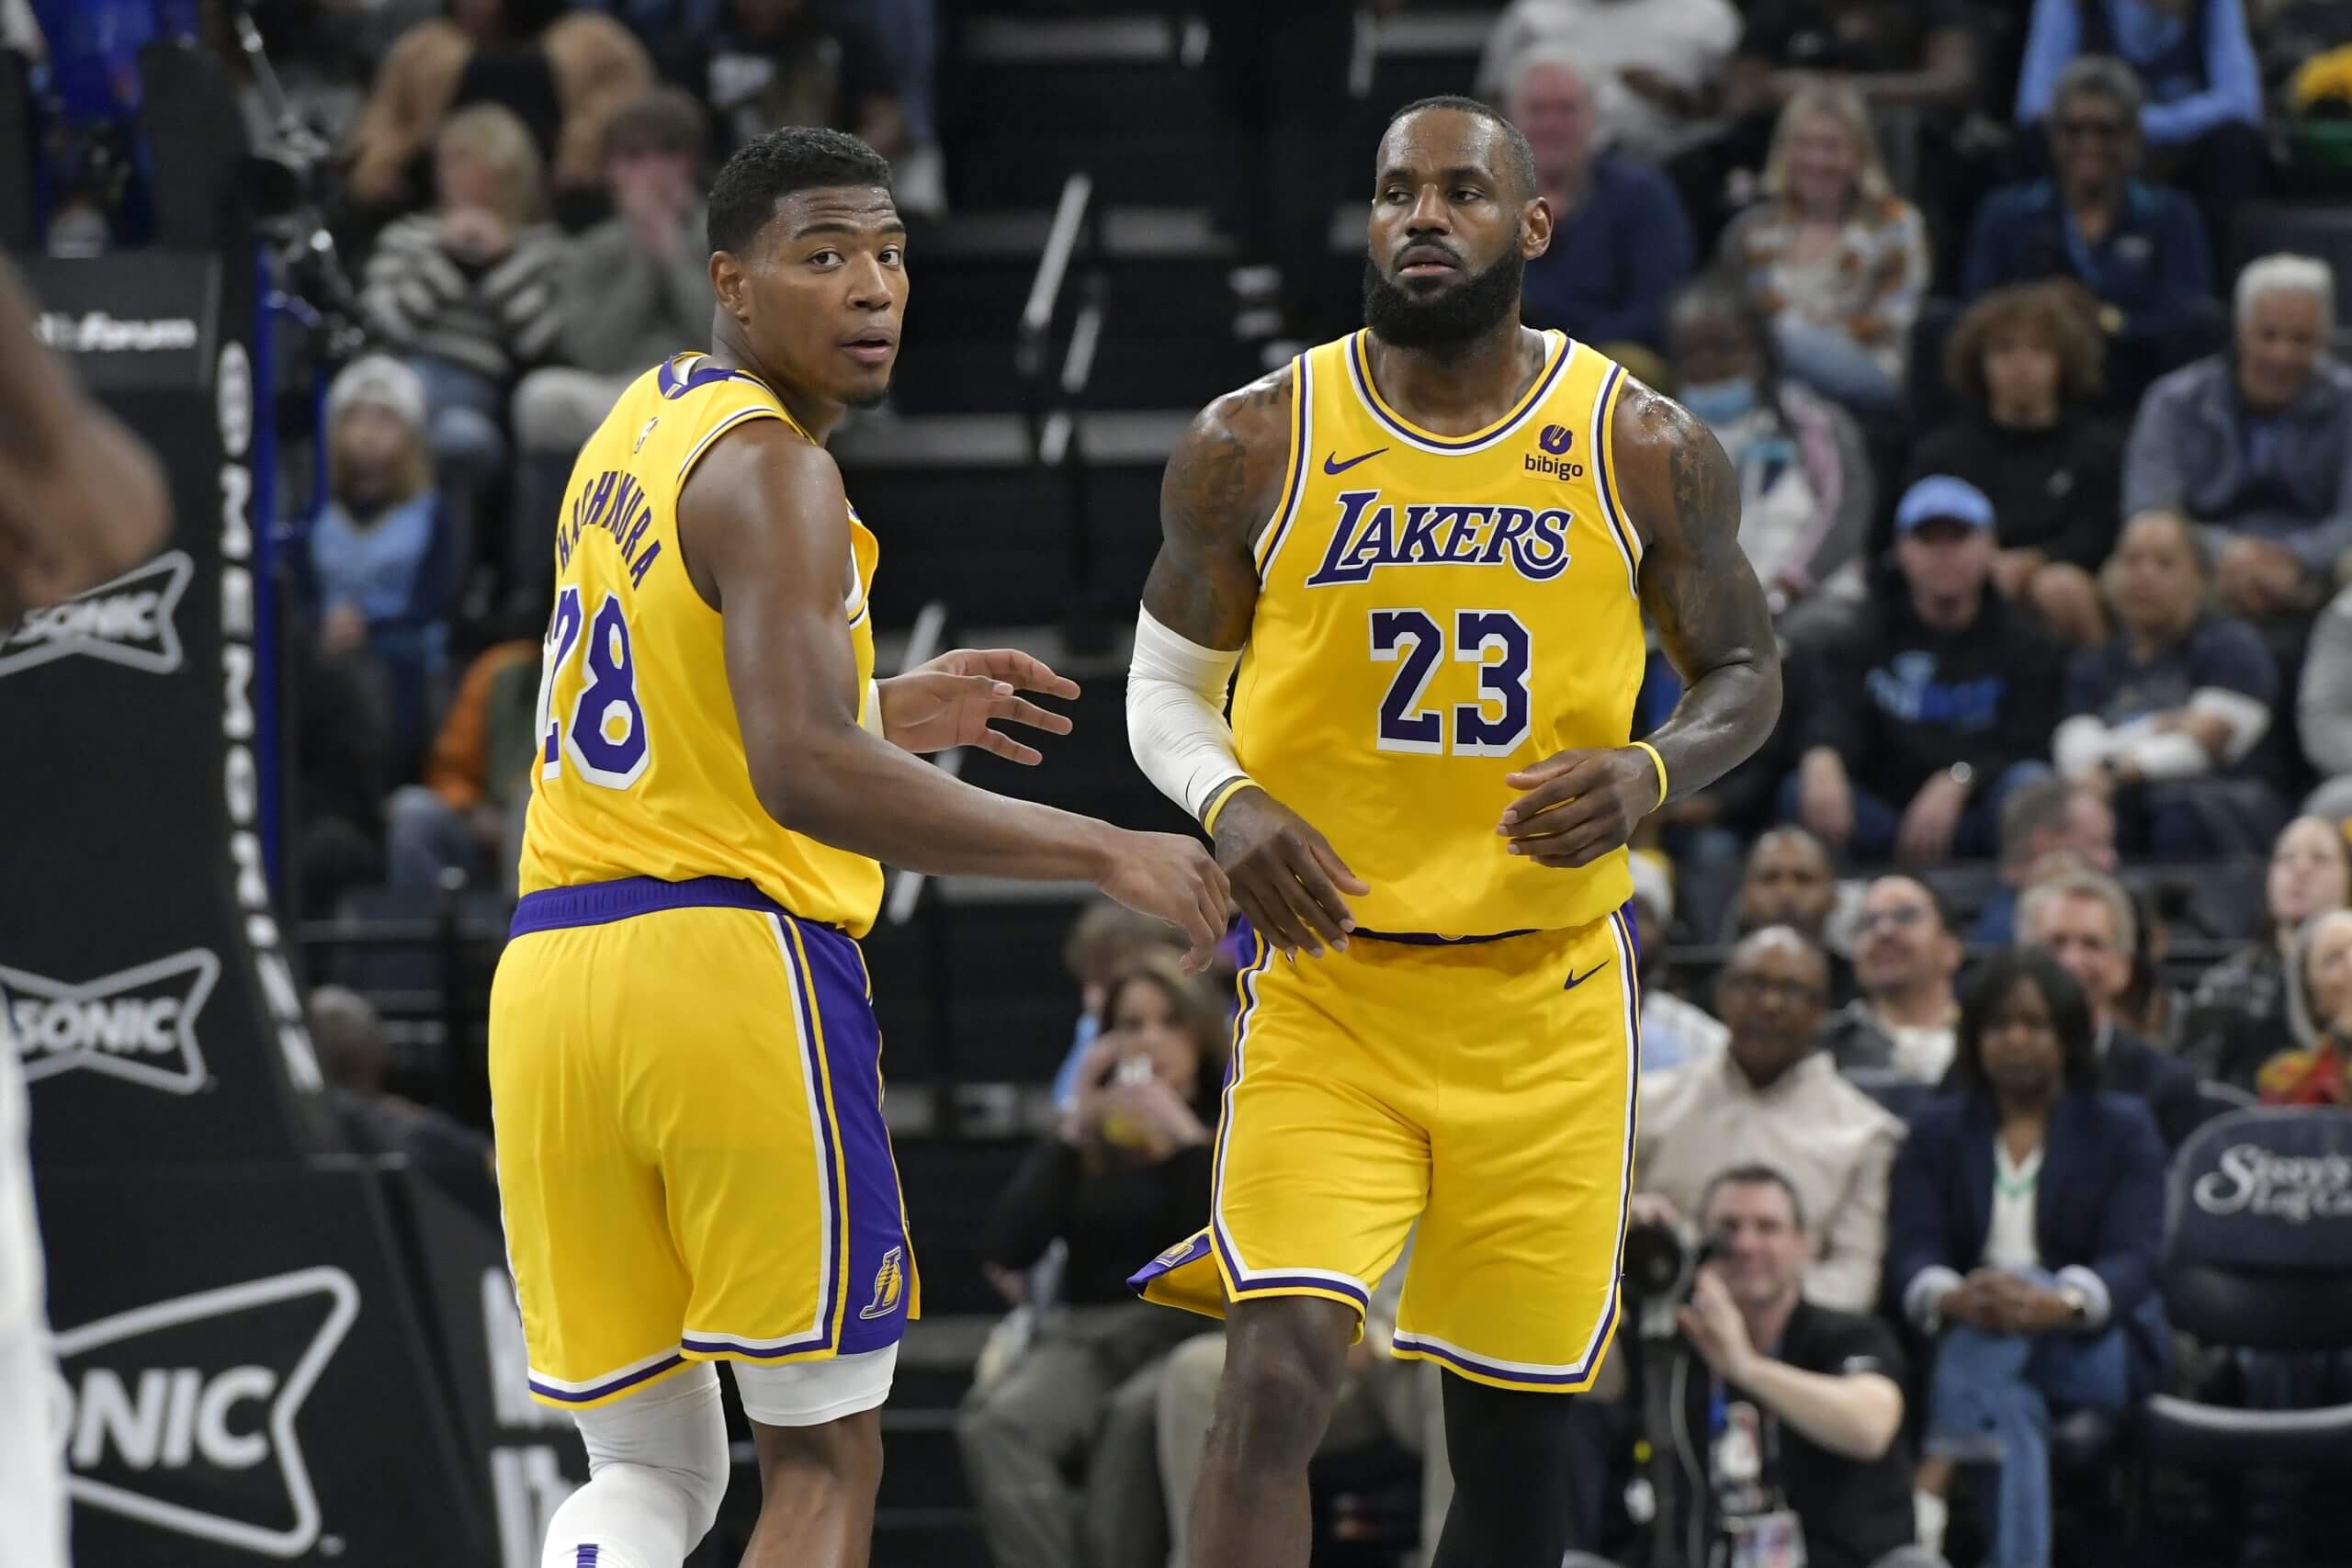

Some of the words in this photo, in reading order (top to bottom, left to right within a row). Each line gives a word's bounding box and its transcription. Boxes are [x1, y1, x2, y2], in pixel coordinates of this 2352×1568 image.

[1525, 454, 1584, 481] bibigo
[1305, 489, 1573, 588] LAKERS
[537, 583, 651, 792] 28
[1368, 607, 1532, 758] 23
[14, 997, 180, 1054] SONIC
